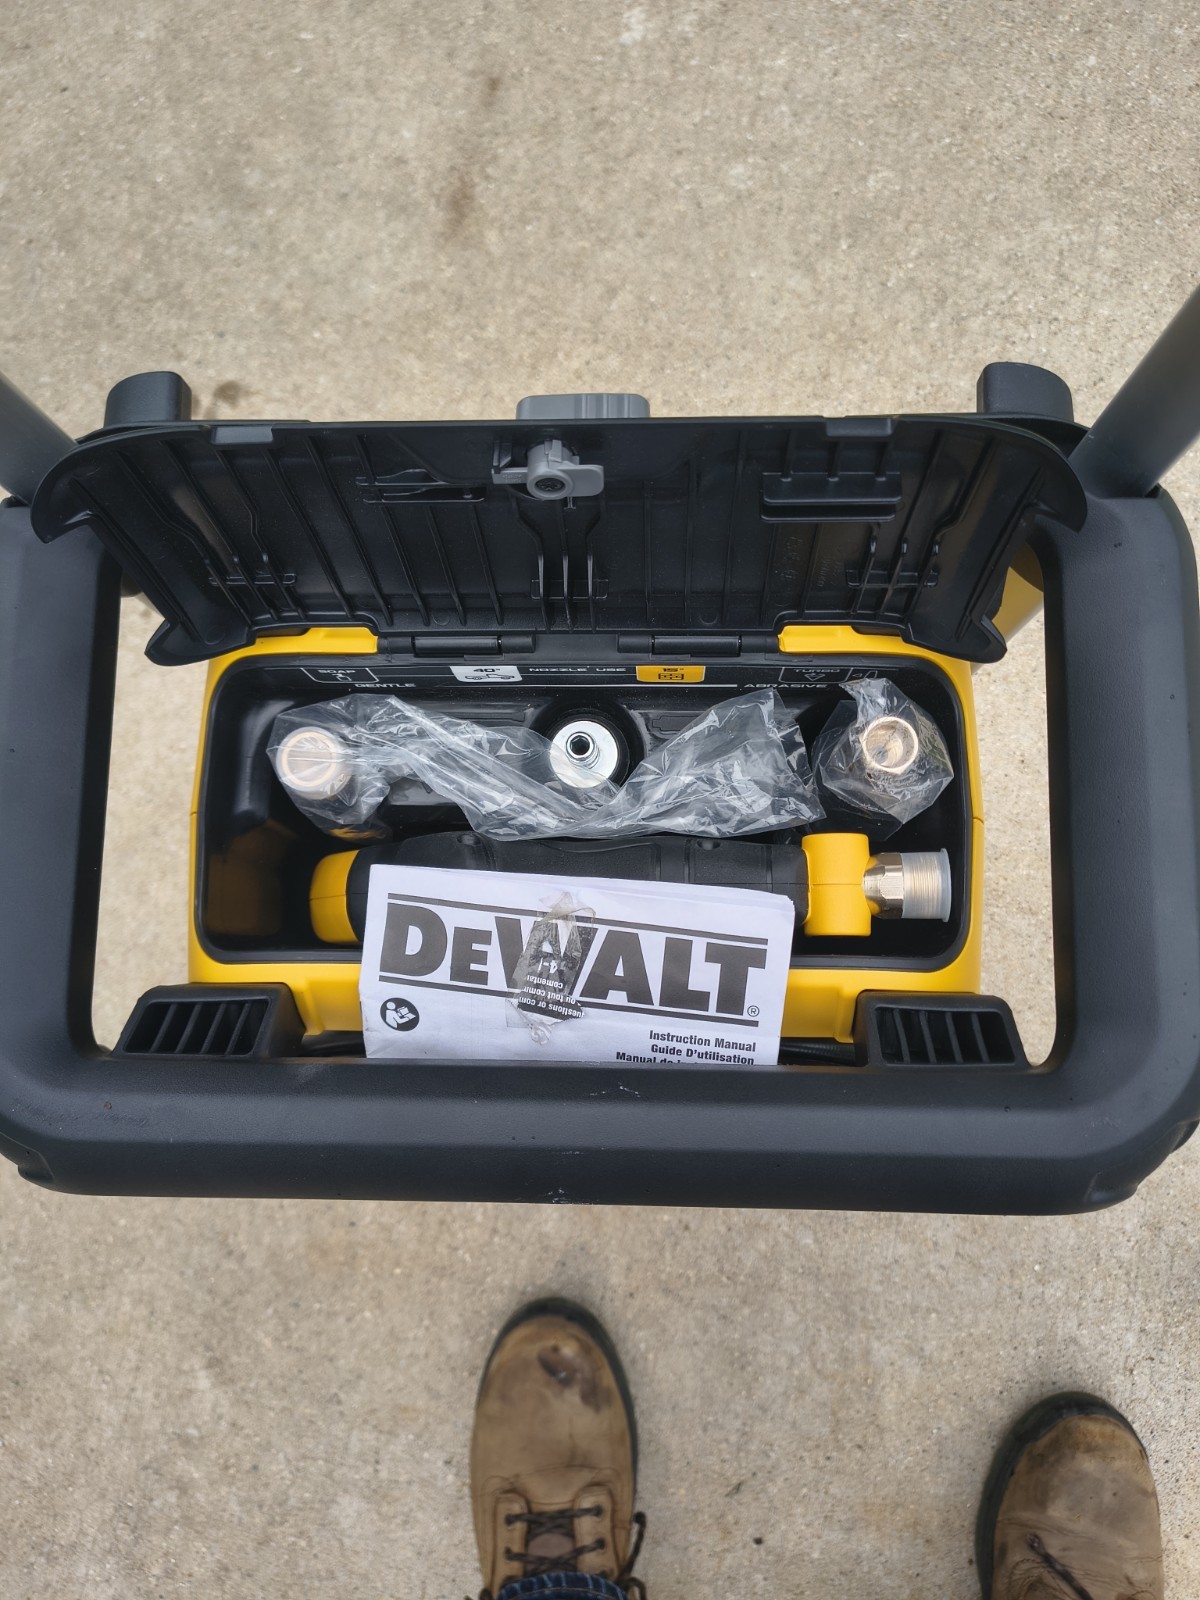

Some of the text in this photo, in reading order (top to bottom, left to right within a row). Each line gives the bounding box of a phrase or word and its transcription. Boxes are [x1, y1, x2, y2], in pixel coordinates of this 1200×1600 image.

[546, 991, 564, 1002] tout
[537, 1001, 547, 1009] or
[649, 1030, 756, 1053] Instruction Manual
[616, 1051, 656, 1063] Manual
[651, 1044, 754, 1065] Guide D'utilisation
